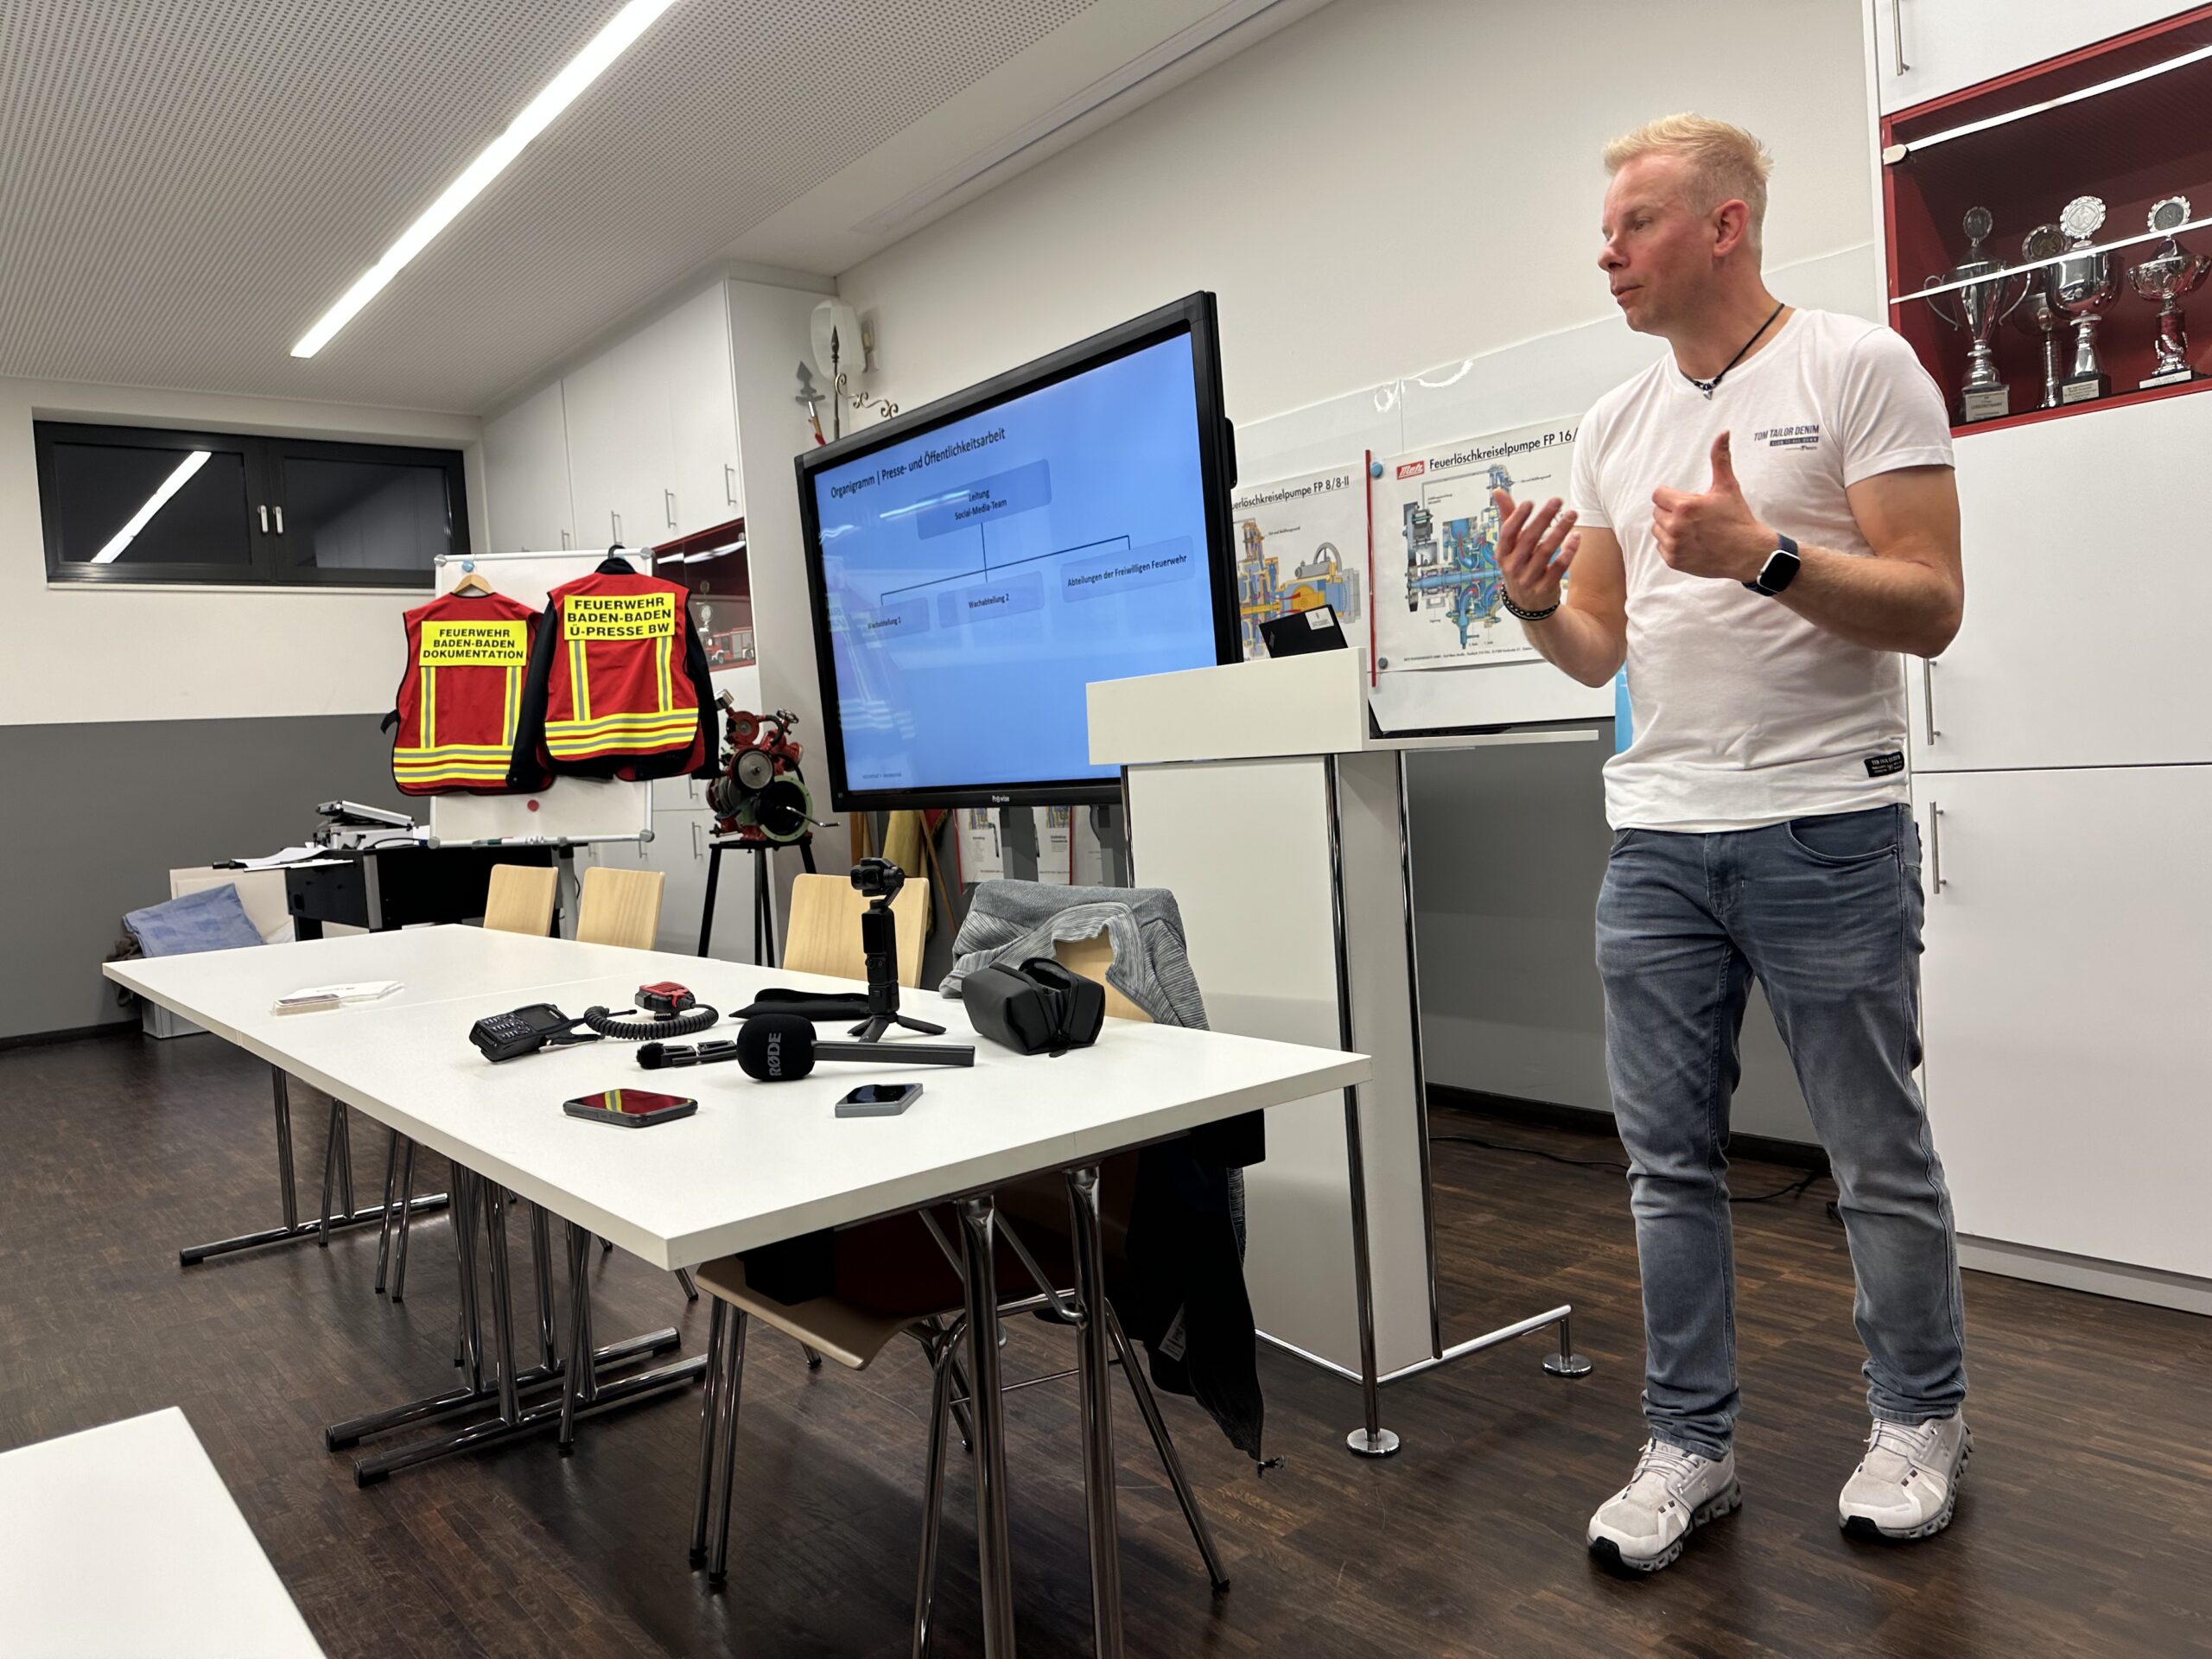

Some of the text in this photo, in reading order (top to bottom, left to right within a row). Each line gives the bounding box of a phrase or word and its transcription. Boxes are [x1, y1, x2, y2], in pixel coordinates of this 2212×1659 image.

[1754, 424, 1819, 441] TOM TAILOR DENIM
[1429, 439, 1541, 470] Feuerlöschkreiselpumpe
[1543, 433, 1555, 446] FP
[831, 474, 875, 499] Organigramm
[882, 466, 907, 481] Presse-
[909, 456, 923, 472] und
[924, 428, 1005, 467] Öffentlichkeitsarbeit
[1399, 461, 1424, 479] Metz
[1313, 481, 1323, 493] FP
[1325, 475, 1349, 491] 8/8-II
[969, 489, 990, 502] Leitung
[954, 499, 1007, 520] Social-Media-Team
[1068, 554, 1187, 588] Abteilungen der Freiwilligen Feuerwehr
[575, 597, 664, 610] FEUERWEHR
[1005, 593, 1010, 601] 2
[567, 609, 671, 622] BADEN-BADEN
[439, 629, 510, 637] FEUERWEHR
[570, 623, 670, 636] Ü-PRESSE BW
[433, 639, 515, 648] BADEN-BADEN
[423, 650, 524, 659] DOKUMENTATION
[767, 1033, 782, 1076] RØDE
